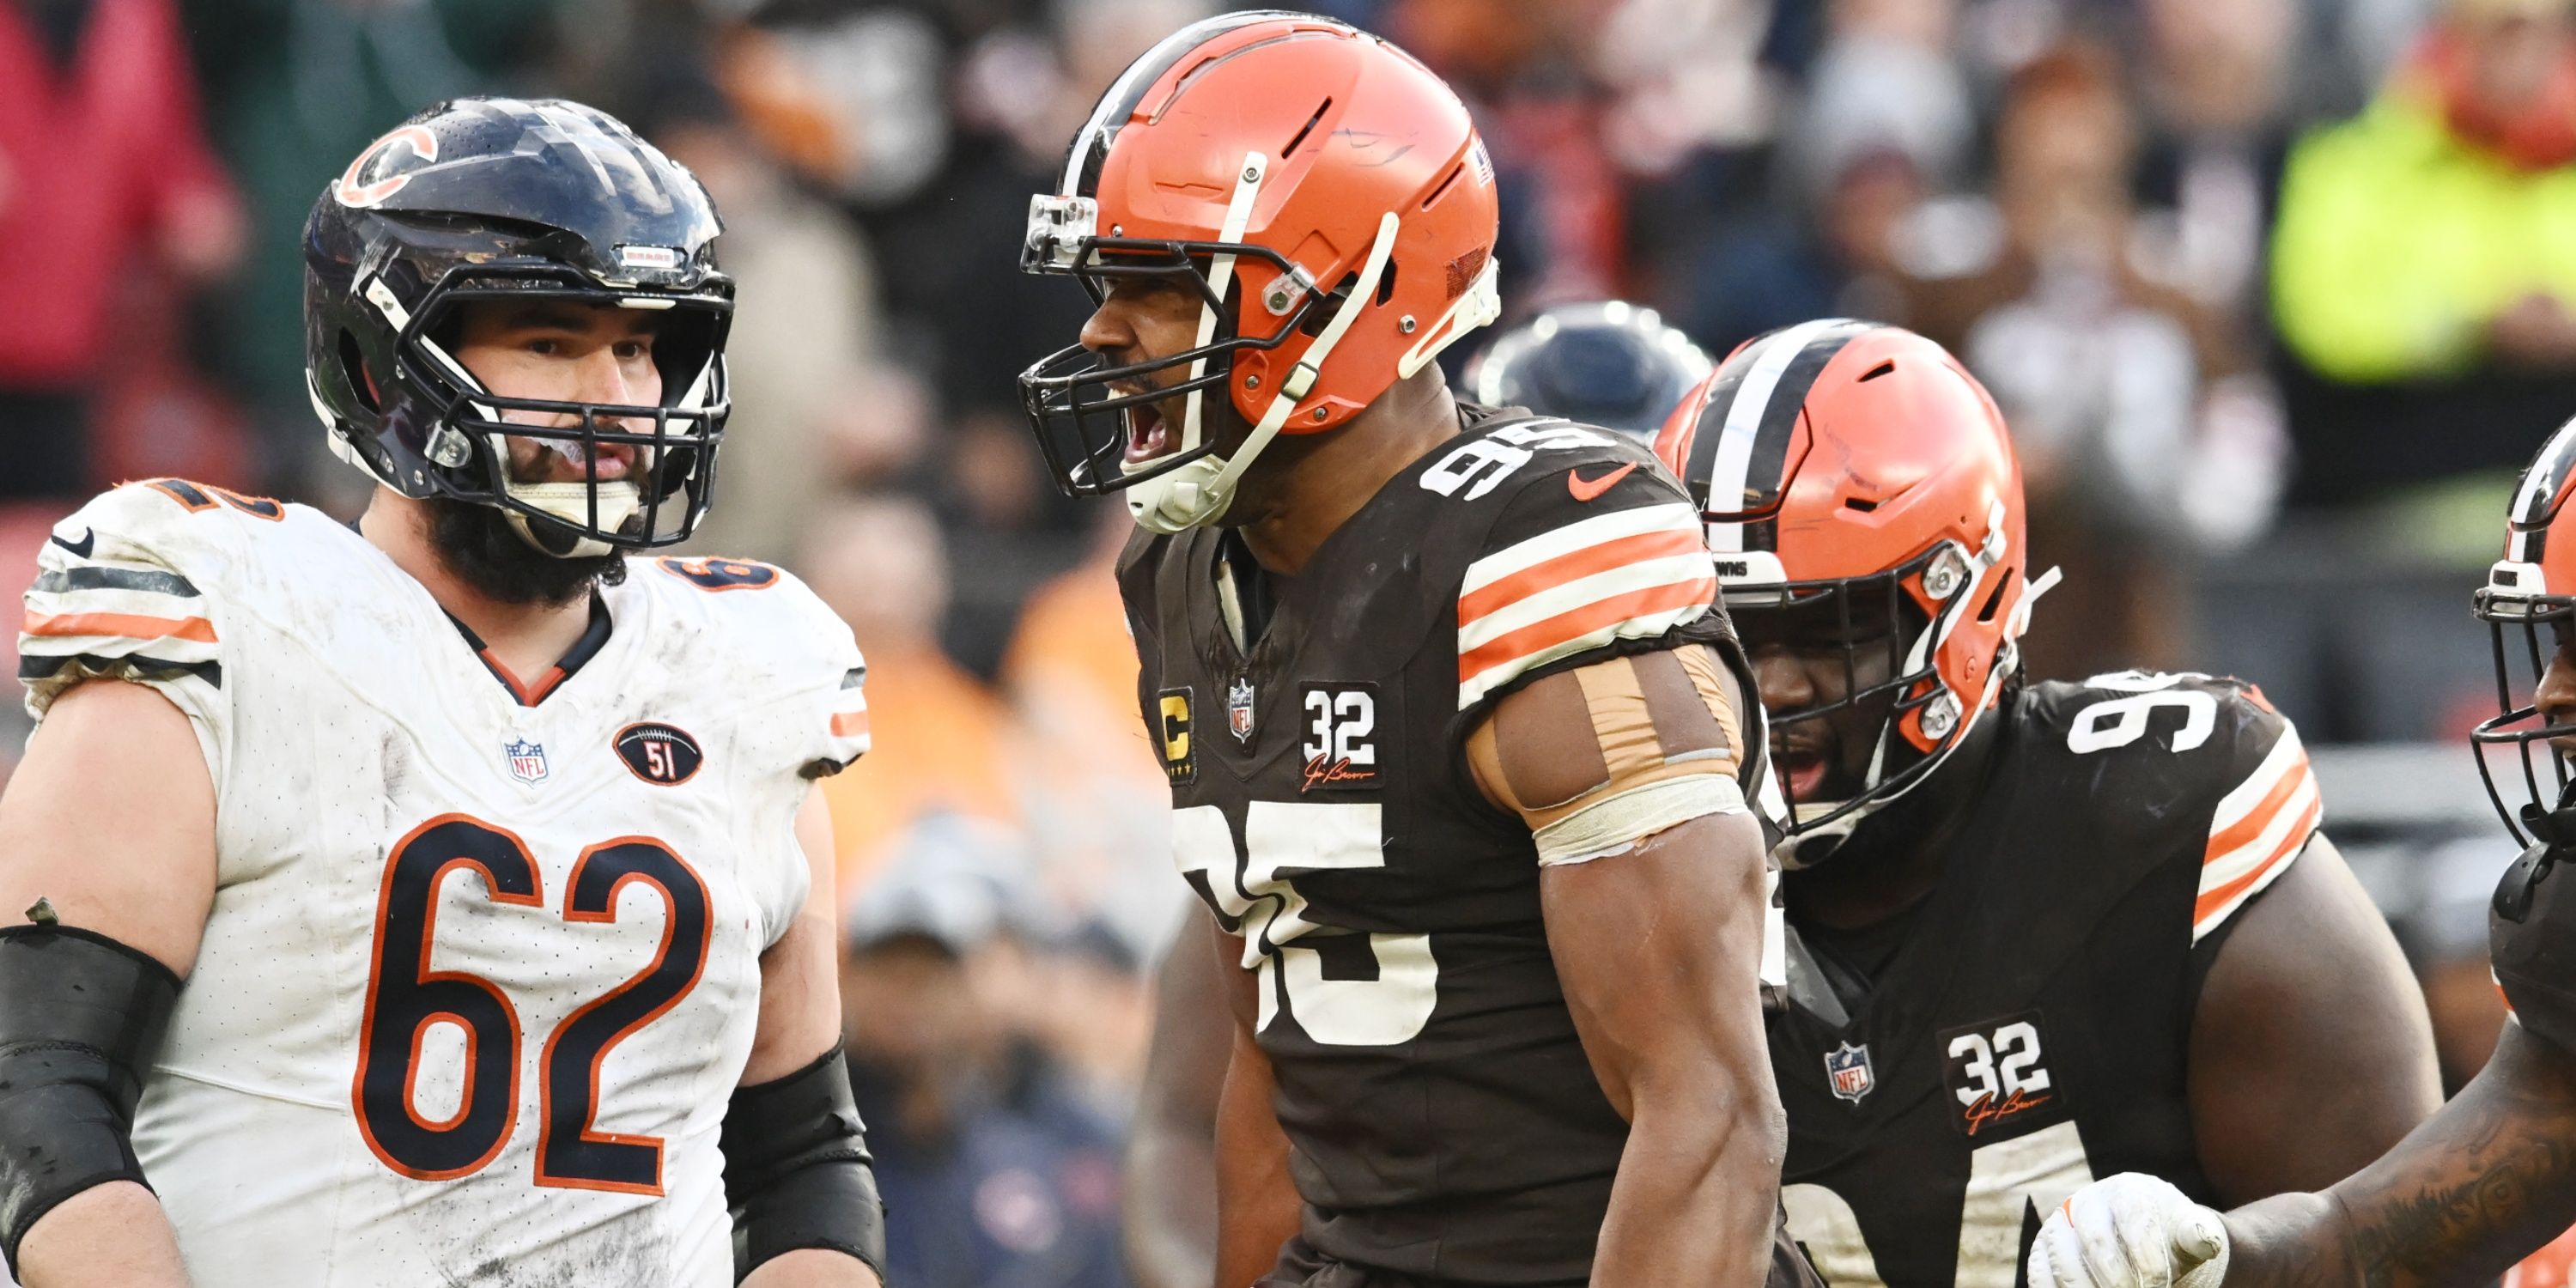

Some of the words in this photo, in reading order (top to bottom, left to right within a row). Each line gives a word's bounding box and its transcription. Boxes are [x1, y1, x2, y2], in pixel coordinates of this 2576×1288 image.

[336, 125, 439, 208] C
[1419, 418, 1617, 501] 95
[1160, 696, 1189, 761] C
[1232, 708, 1250, 732] NFL
[1303, 690, 1375, 764] 32
[511, 756, 544, 776] NFL
[645, 742, 677, 780] 51
[1172, 800, 1438, 1046] 95
[352, 812, 714, 1197] 62
[1836, 1069, 1867, 1093] NFL
[1948, 1021, 2050, 1107] 32
